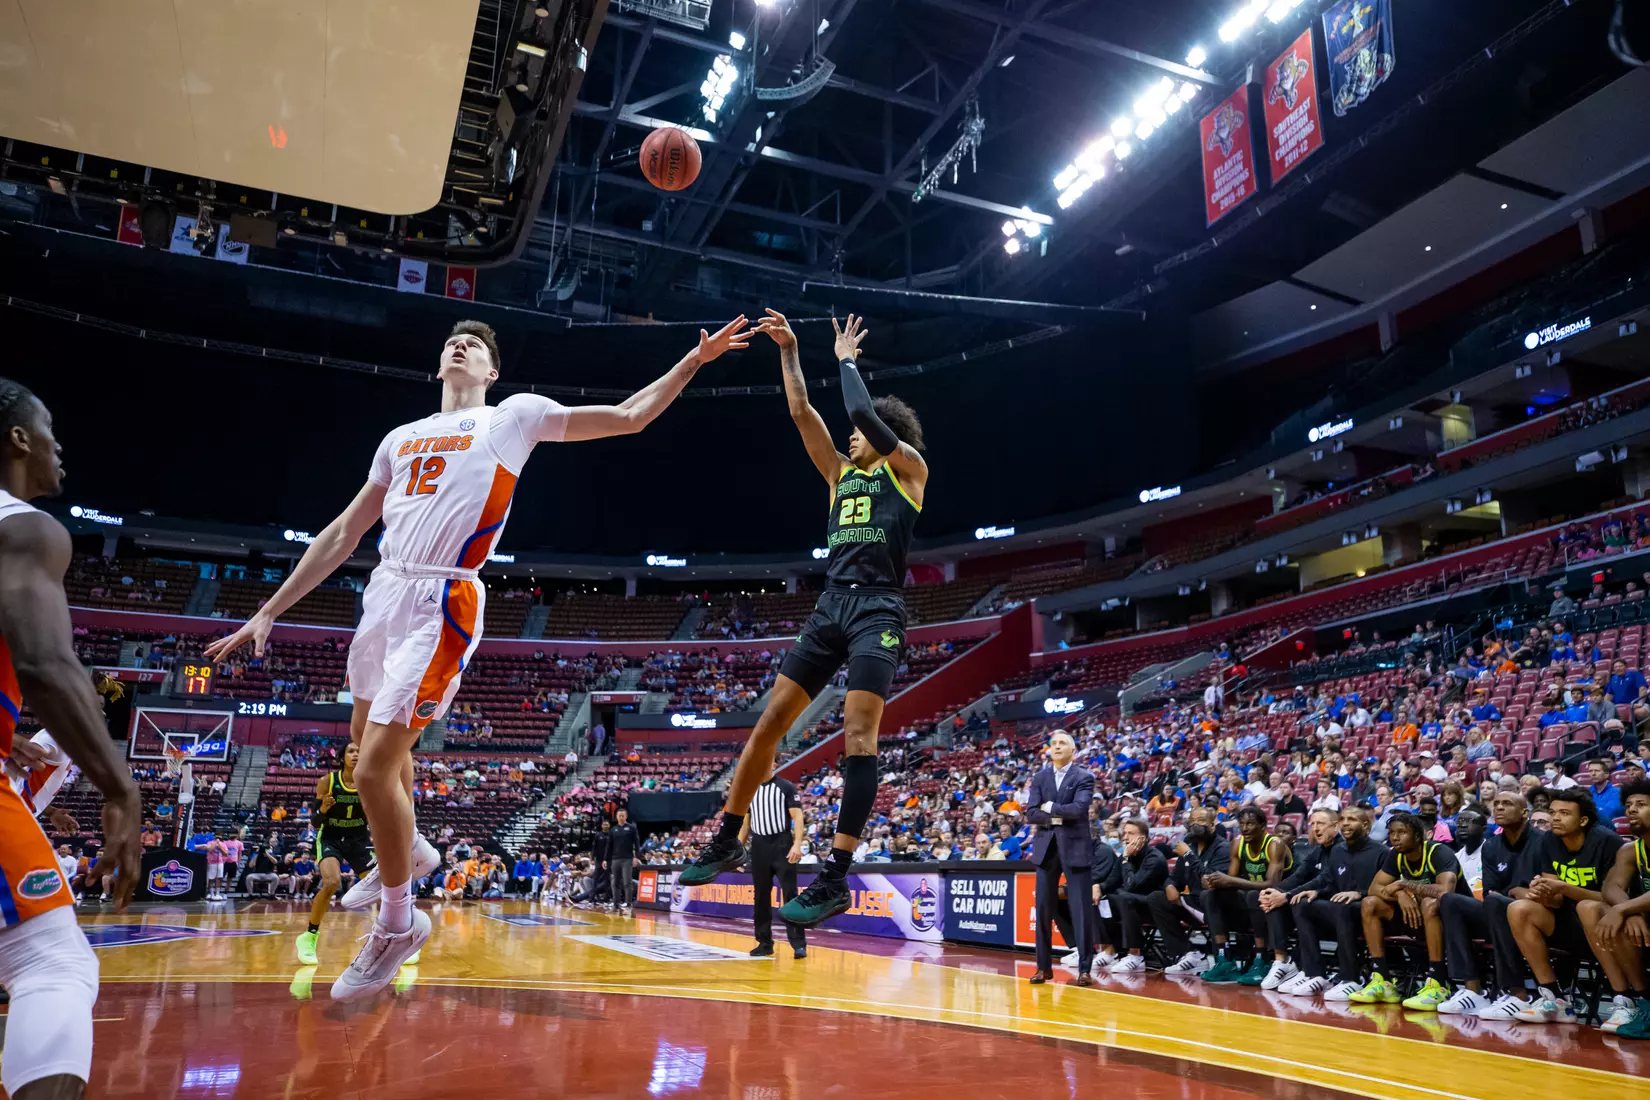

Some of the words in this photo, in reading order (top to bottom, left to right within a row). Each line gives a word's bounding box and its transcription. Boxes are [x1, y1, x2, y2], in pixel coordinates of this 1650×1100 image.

[1273, 96, 1310, 138] SOUTHEAST
[1278, 112, 1308, 146] DIVISION
[1275, 120, 1315, 161] CHAMPIONS
[1285, 140, 1308, 168] 2011-12
[1213, 150, 1243, 181] ATLANTIC
[1215, 161, 1243, 189] DIVISION
[1211, 168, 1249, 204] CHAMPIONS
[1539, 323, 1557, 338] VISIT
[1540, 316, 1591, 345] LAUDERDALE
[460, 421, 475, 430] SEC
[397, 435, 474, 457] GATORS
[405, 456, 446, 496] 12
[837, 479, 880, 498] SOUTH
[82, 513, 123, 523] LAUDERDALE
[83, 508, 99, 516] VISIT
[839, 496, 871, 526] 23
[827, 528, 886, 549] FLORIDA
[184, 665, 211, 678] 13:10
[188, 677, 206, 693] 17
[238, 702, 266, 715] 2:19
[269, 704, 287, 716] PM
[346, 805, 353, 819] 1
[1553, 861, 1597, 887] USF
[950, 879, 975, 895] SELL
[978, 880, 1008, 896] YOUR
[845, 889, 894, 918] LASSIC
[953, 898, 974, 914] CAR
[976, 899, 1005, 916] NOW!
[958, 920, 998, 931] AutoNation.com
